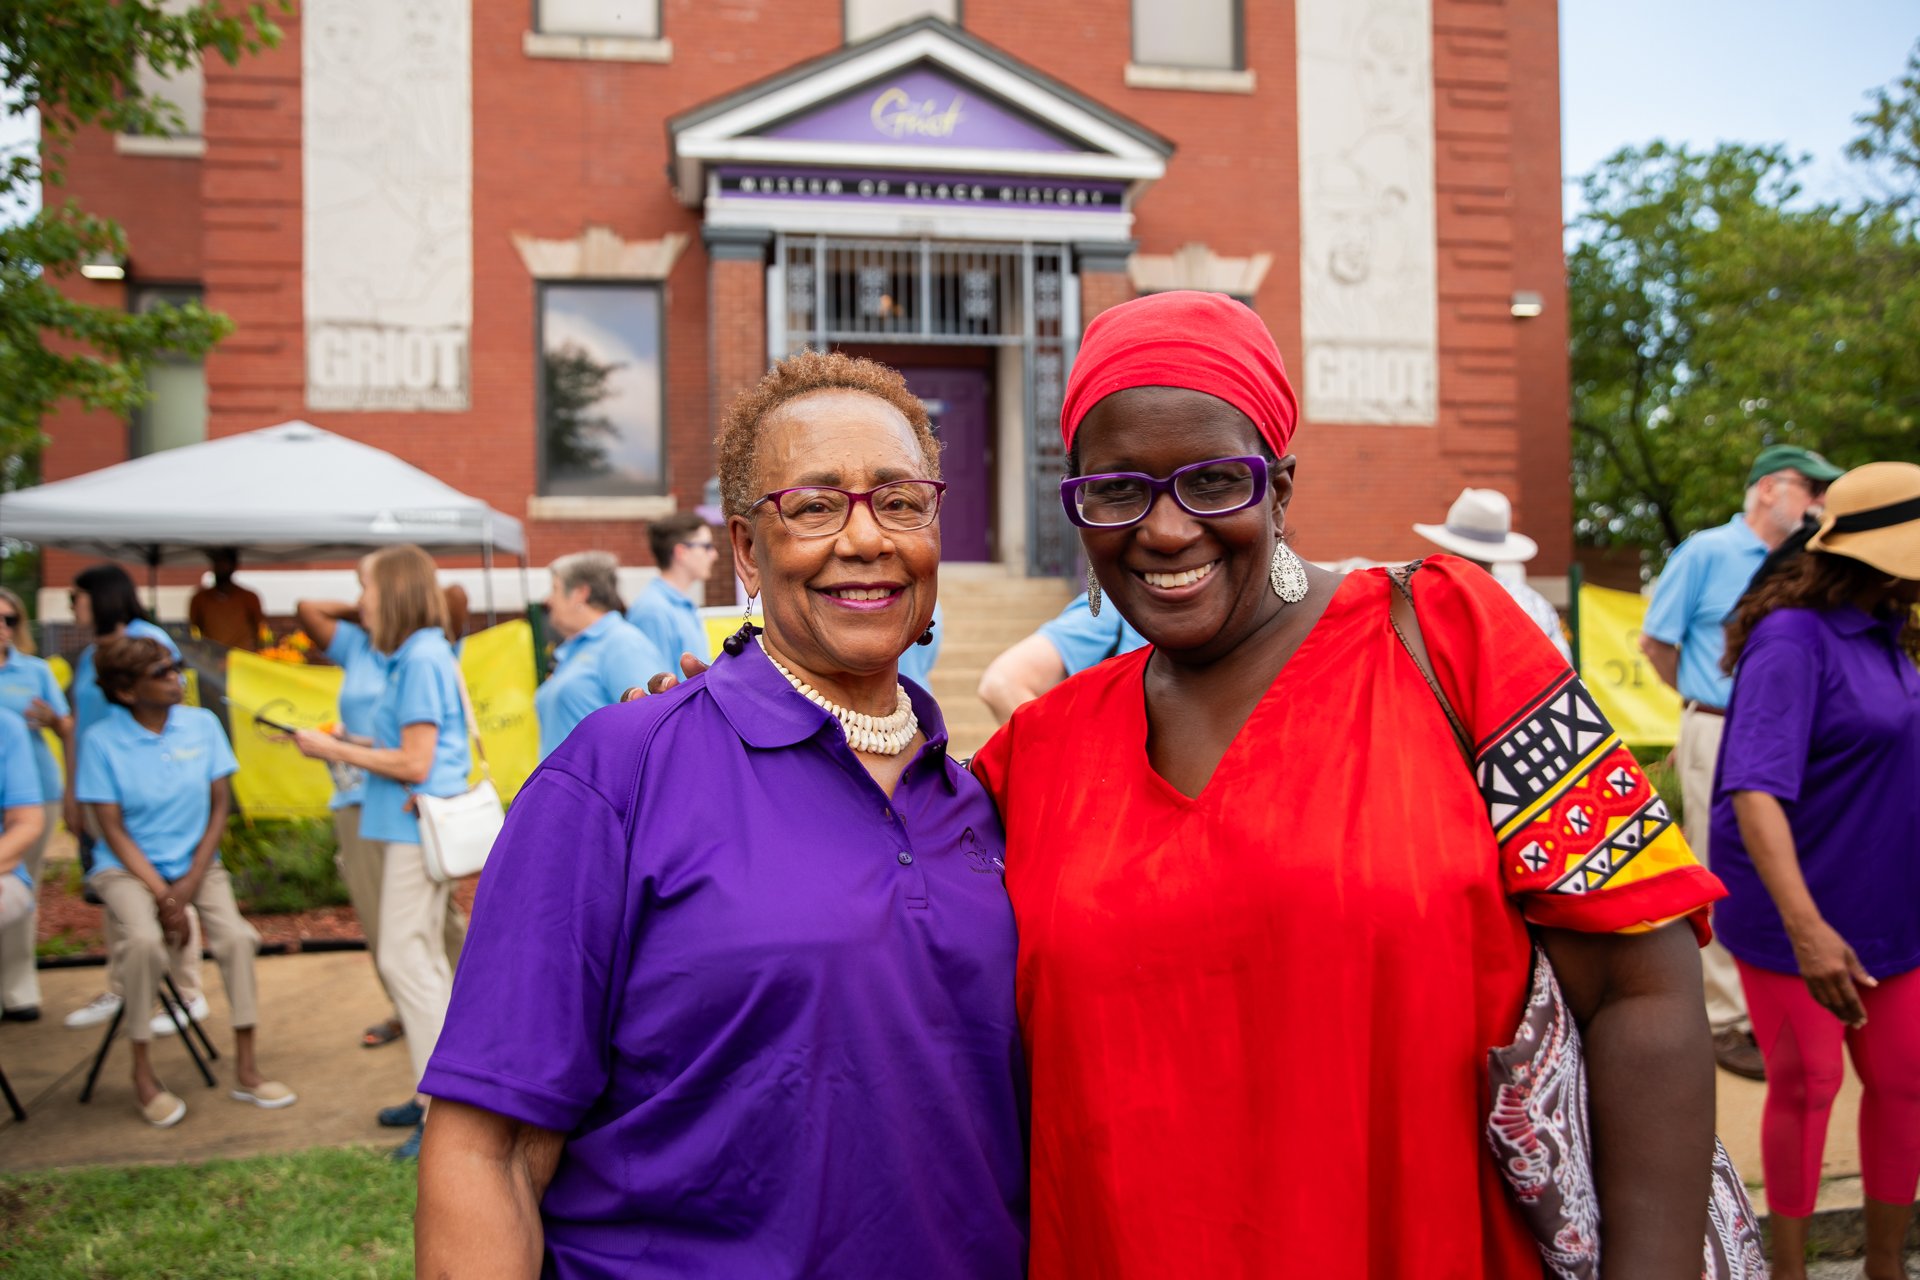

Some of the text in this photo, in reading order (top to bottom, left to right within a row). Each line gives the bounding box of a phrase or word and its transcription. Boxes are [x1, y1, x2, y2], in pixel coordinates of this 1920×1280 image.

[739, 176, 1103, 208] MUSEUM OF BLACK HISTORY
[311, 328, 464, 389] GRIOT
[1306, 346, 1430, 402] GRIOT
